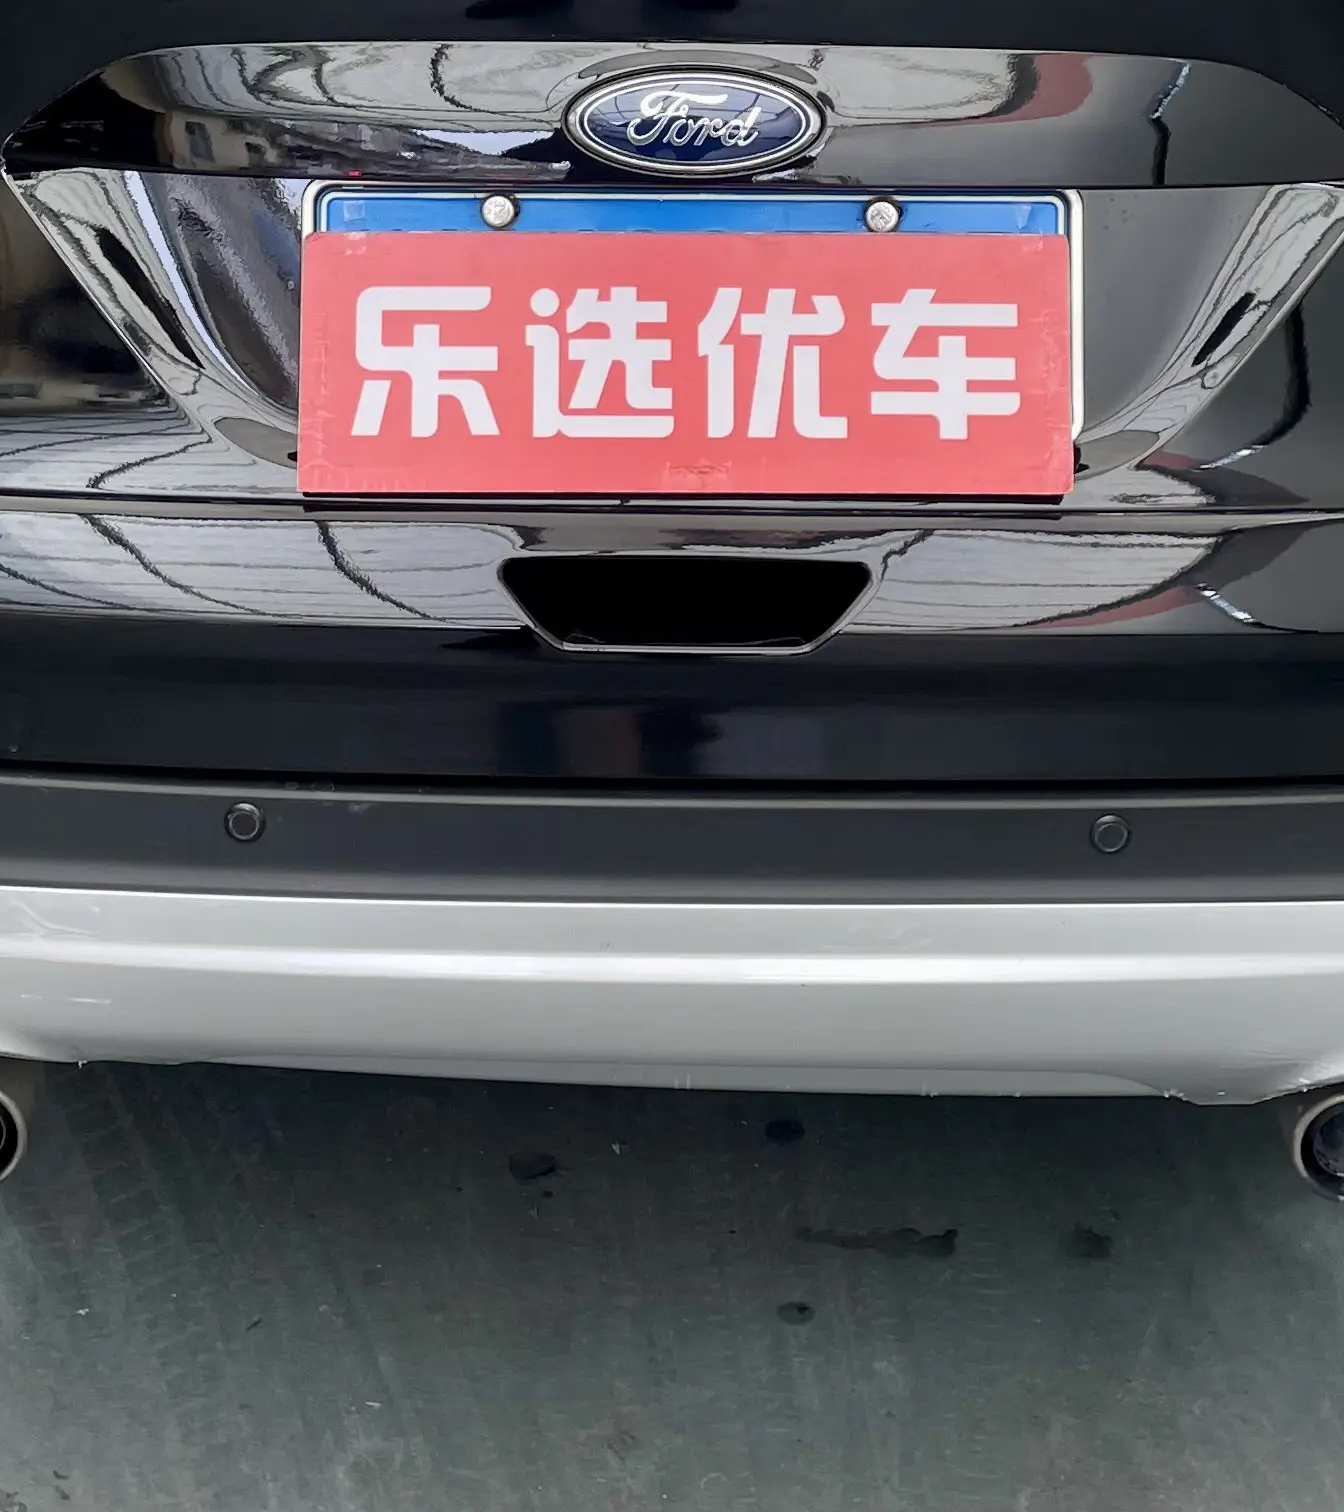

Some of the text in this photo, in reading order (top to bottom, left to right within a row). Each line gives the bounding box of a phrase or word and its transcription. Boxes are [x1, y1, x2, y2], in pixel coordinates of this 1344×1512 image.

[626, 90, 762, 147] Ford
[351, 285, 1021, 440] 乐选优车
